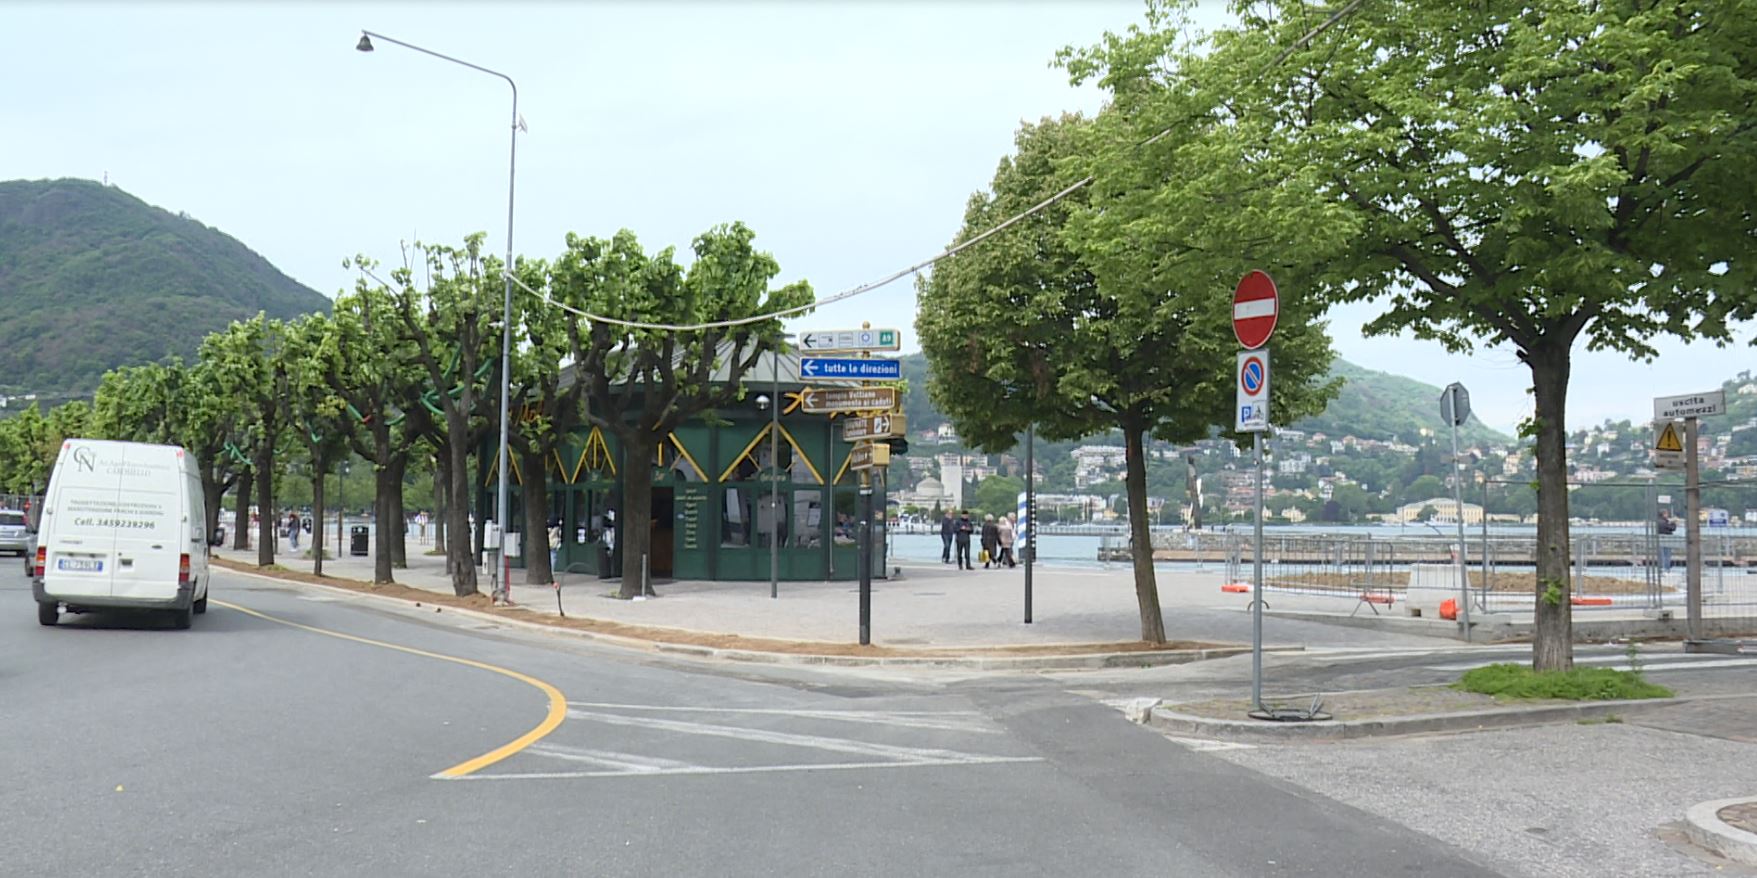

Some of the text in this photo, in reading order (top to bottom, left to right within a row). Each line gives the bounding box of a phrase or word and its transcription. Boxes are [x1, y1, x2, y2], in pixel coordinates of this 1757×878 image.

[824, 363, 897, 374] tutte le direzioni
[825, 399, 862, 407] monumento
[871, 397, 891, 407] caduti
[1672, 397, 1704, 407] uscita
[1663, 405, 1716, 417] automezzi
